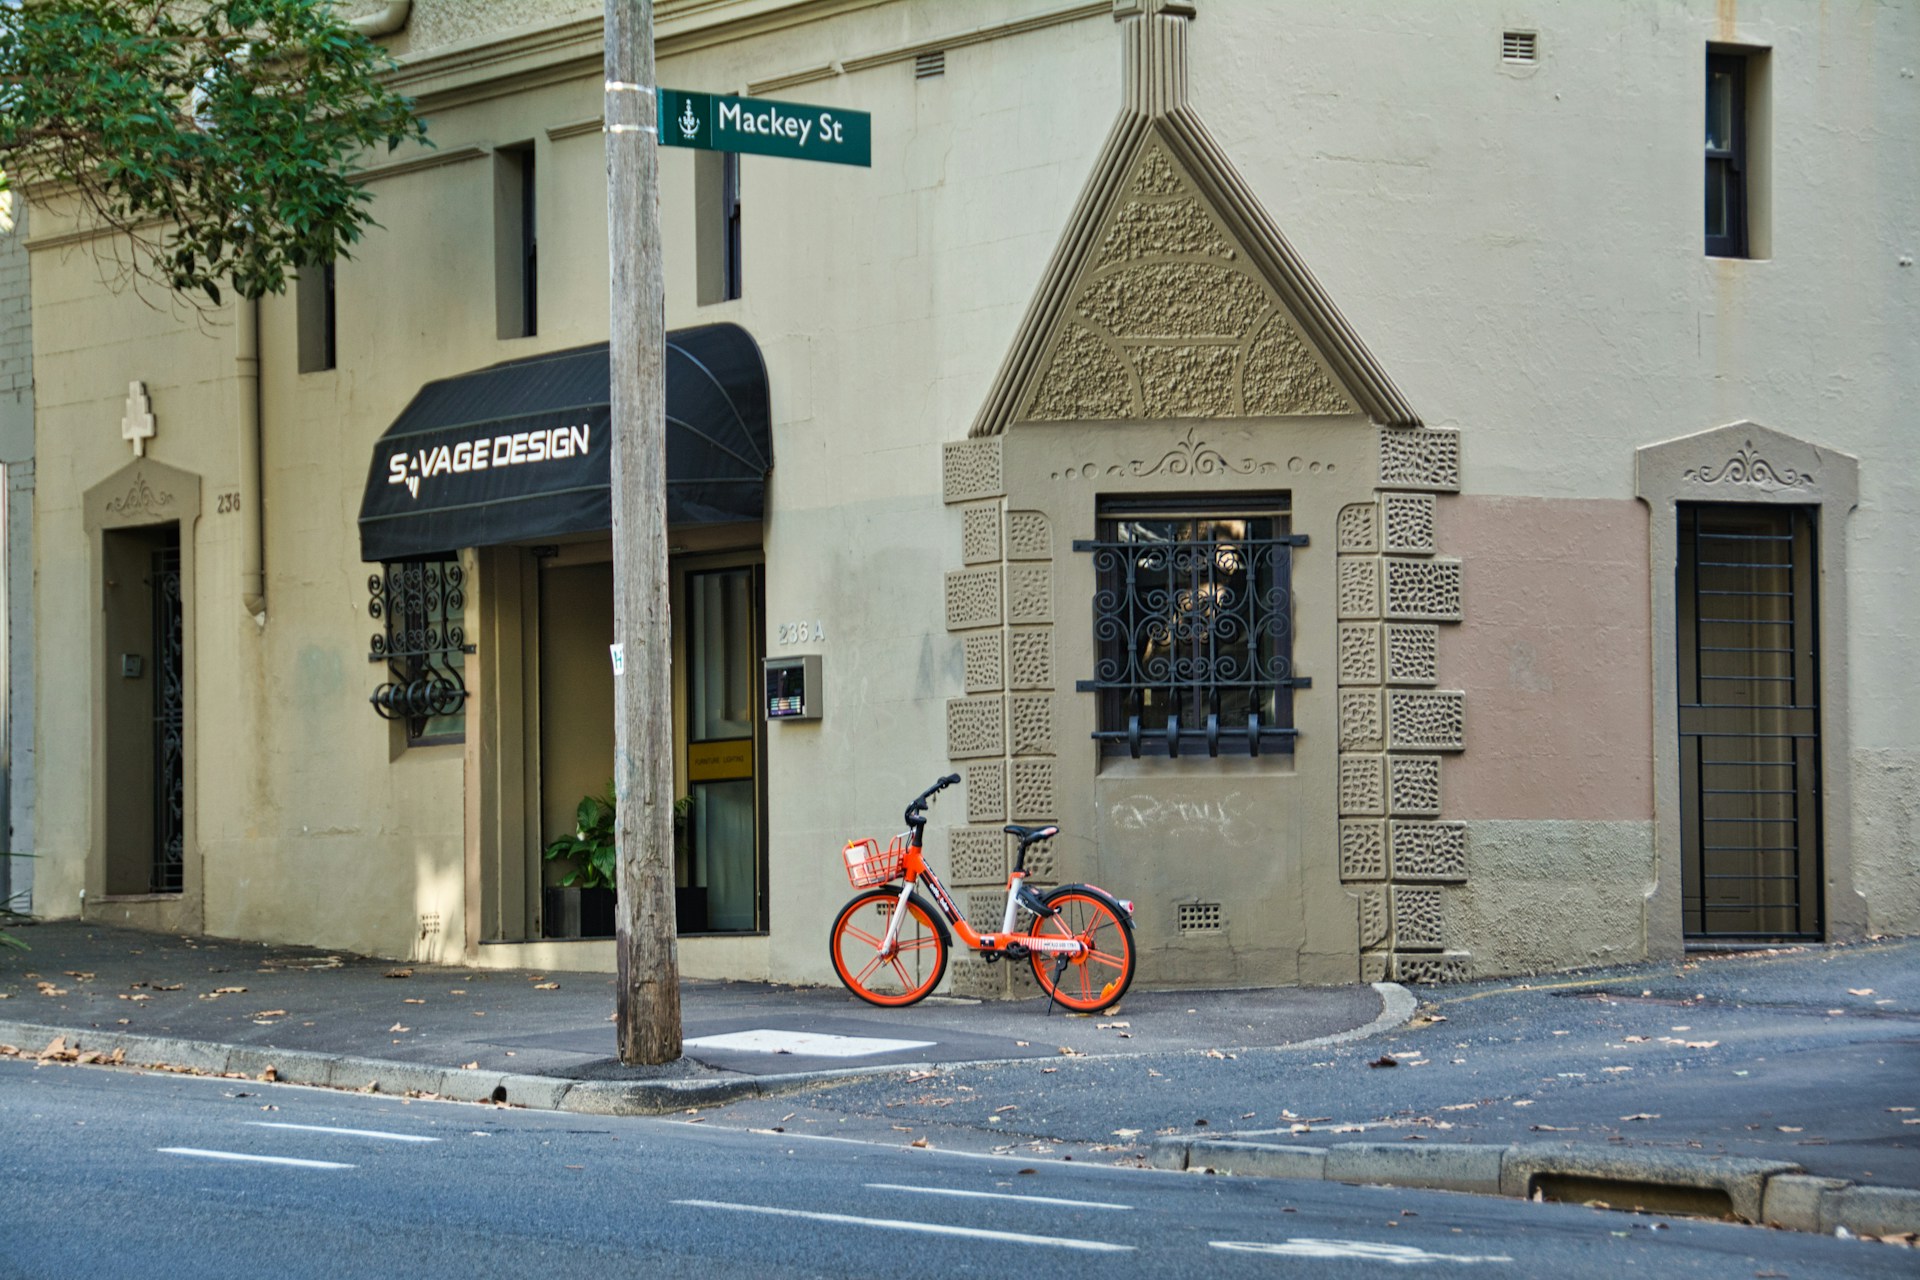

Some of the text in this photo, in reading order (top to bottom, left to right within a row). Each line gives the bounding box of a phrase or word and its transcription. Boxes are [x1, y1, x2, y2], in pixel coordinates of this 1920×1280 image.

[718, 101, 844, 146] Mackey St
[492, 424, 590, 467] DESIGN
[217, 492, 240, 514] 236
[778, 621, 808, 645] 236
